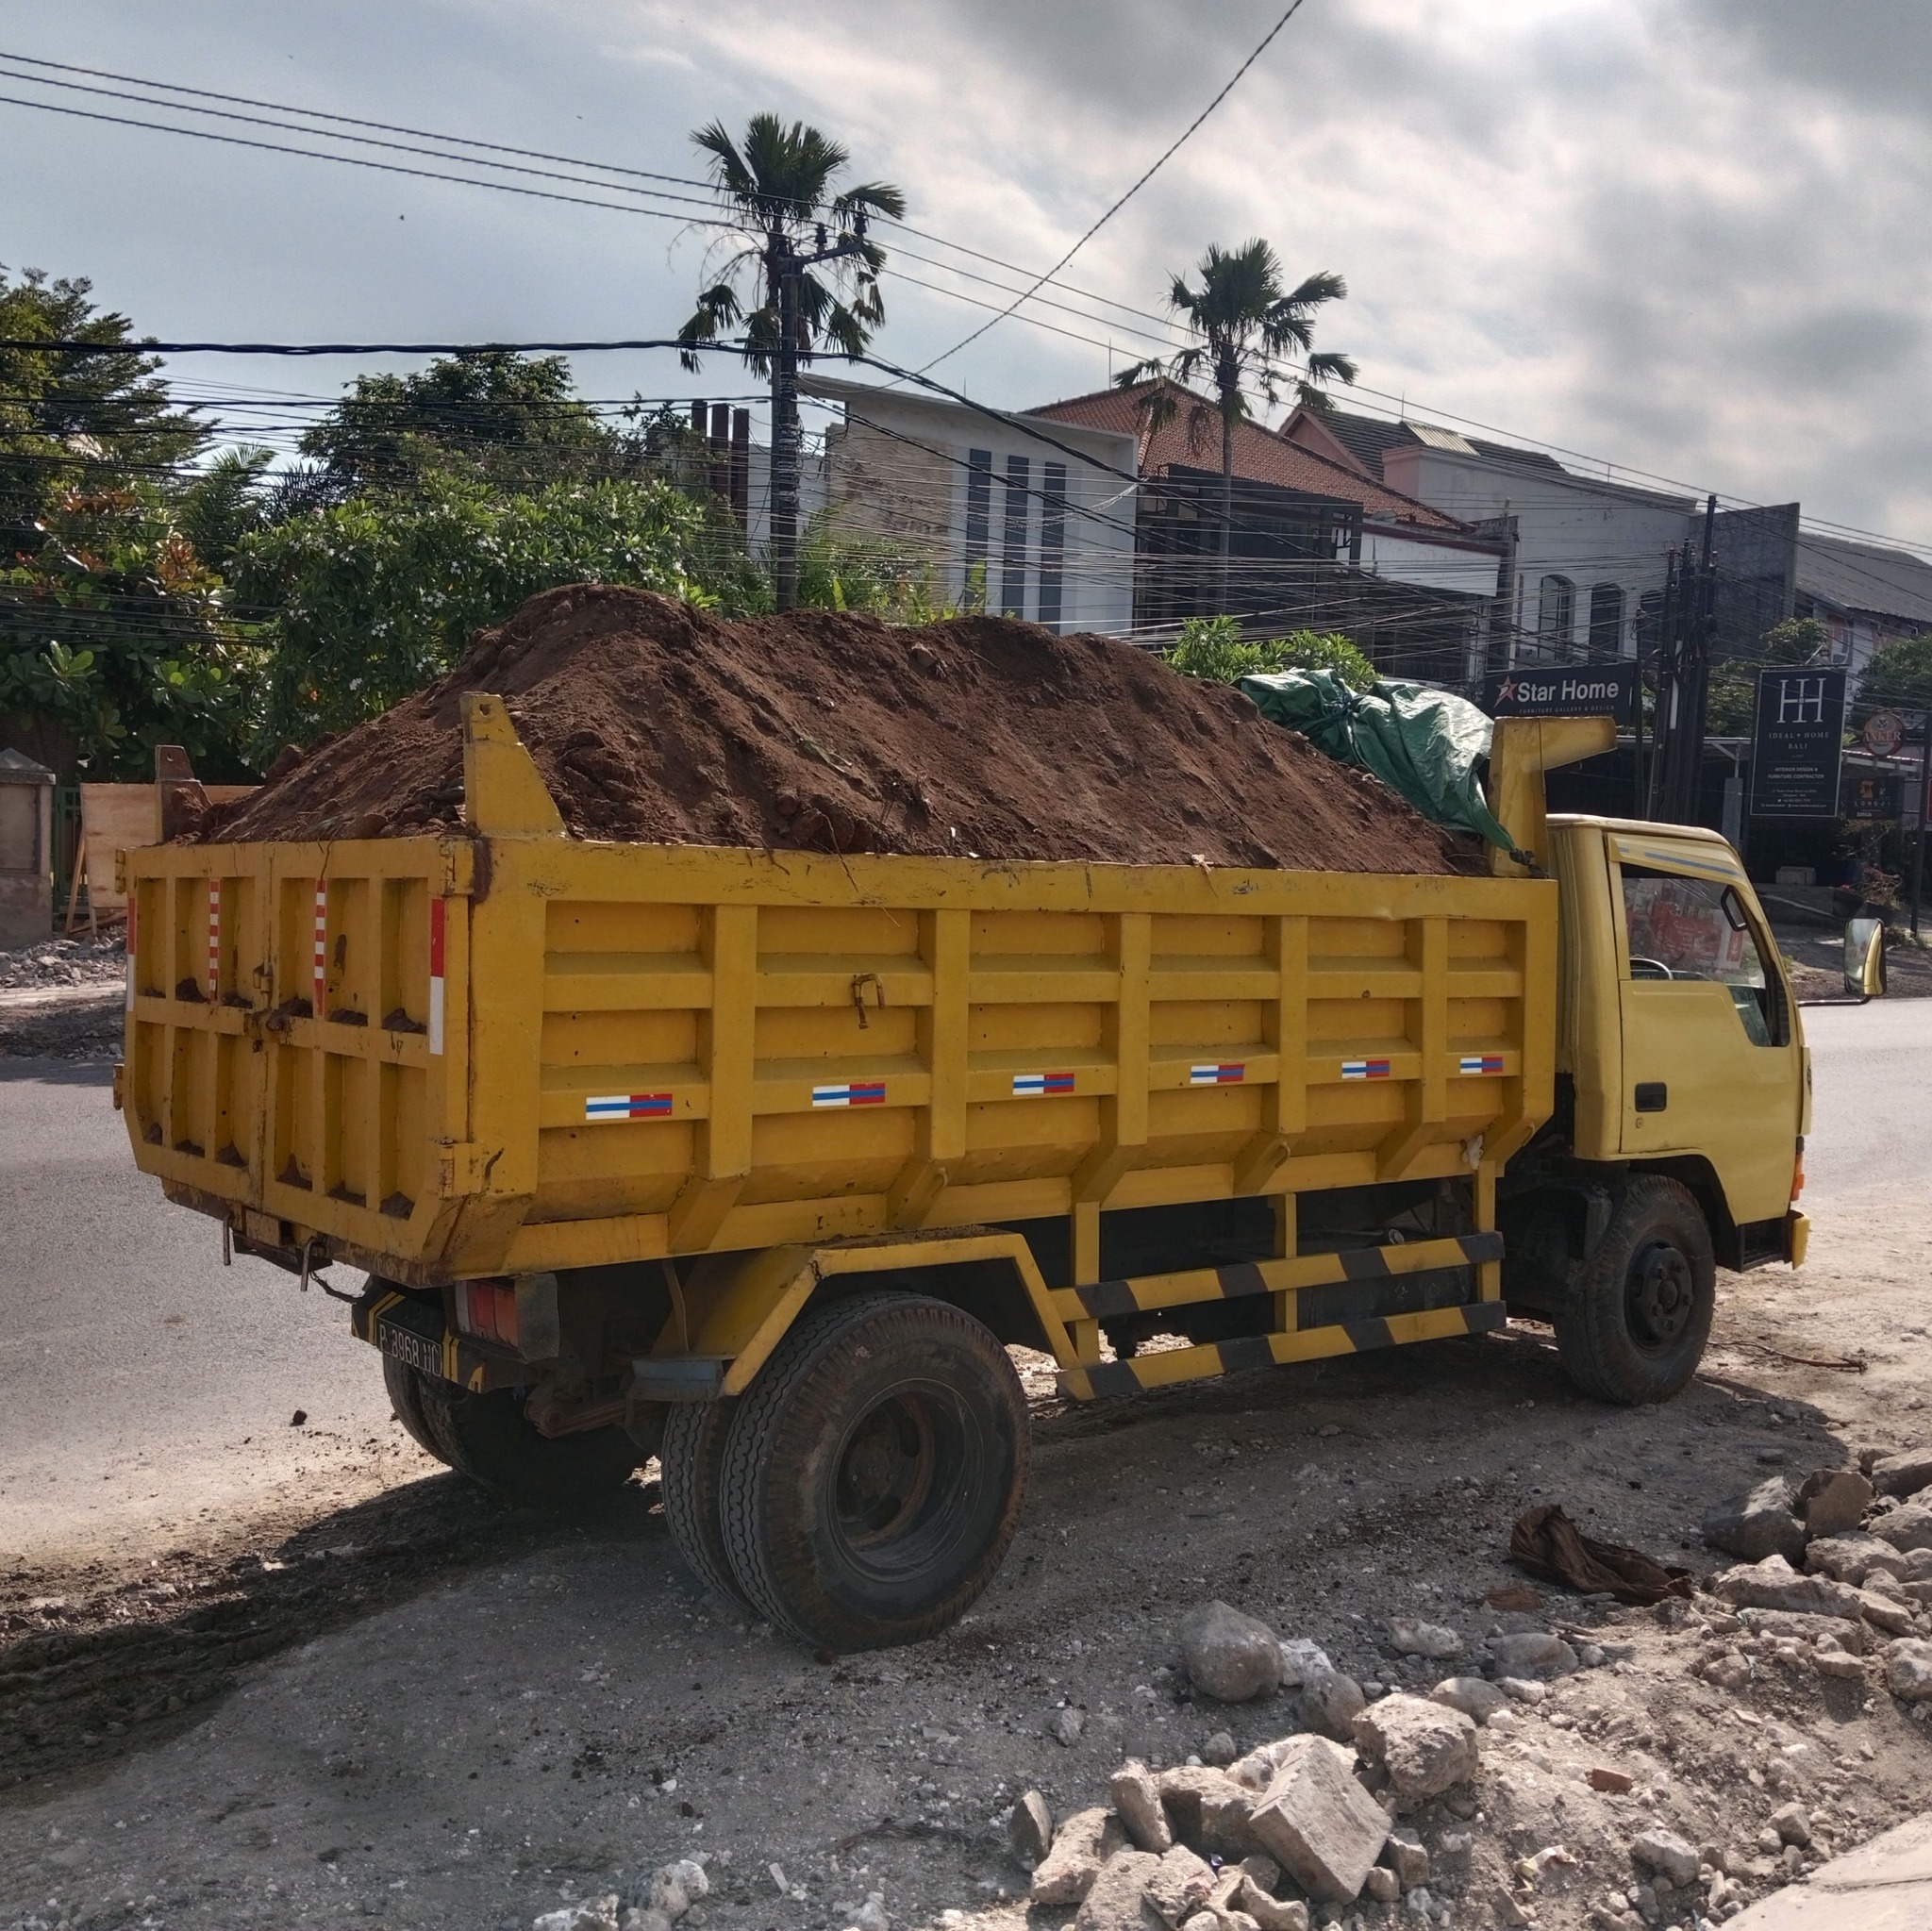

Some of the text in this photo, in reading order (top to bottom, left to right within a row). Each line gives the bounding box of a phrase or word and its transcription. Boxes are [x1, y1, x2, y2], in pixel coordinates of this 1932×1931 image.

[1517, 679, 1619, 703] Star Home
[1862, 731, 1902, 741] ANKER
